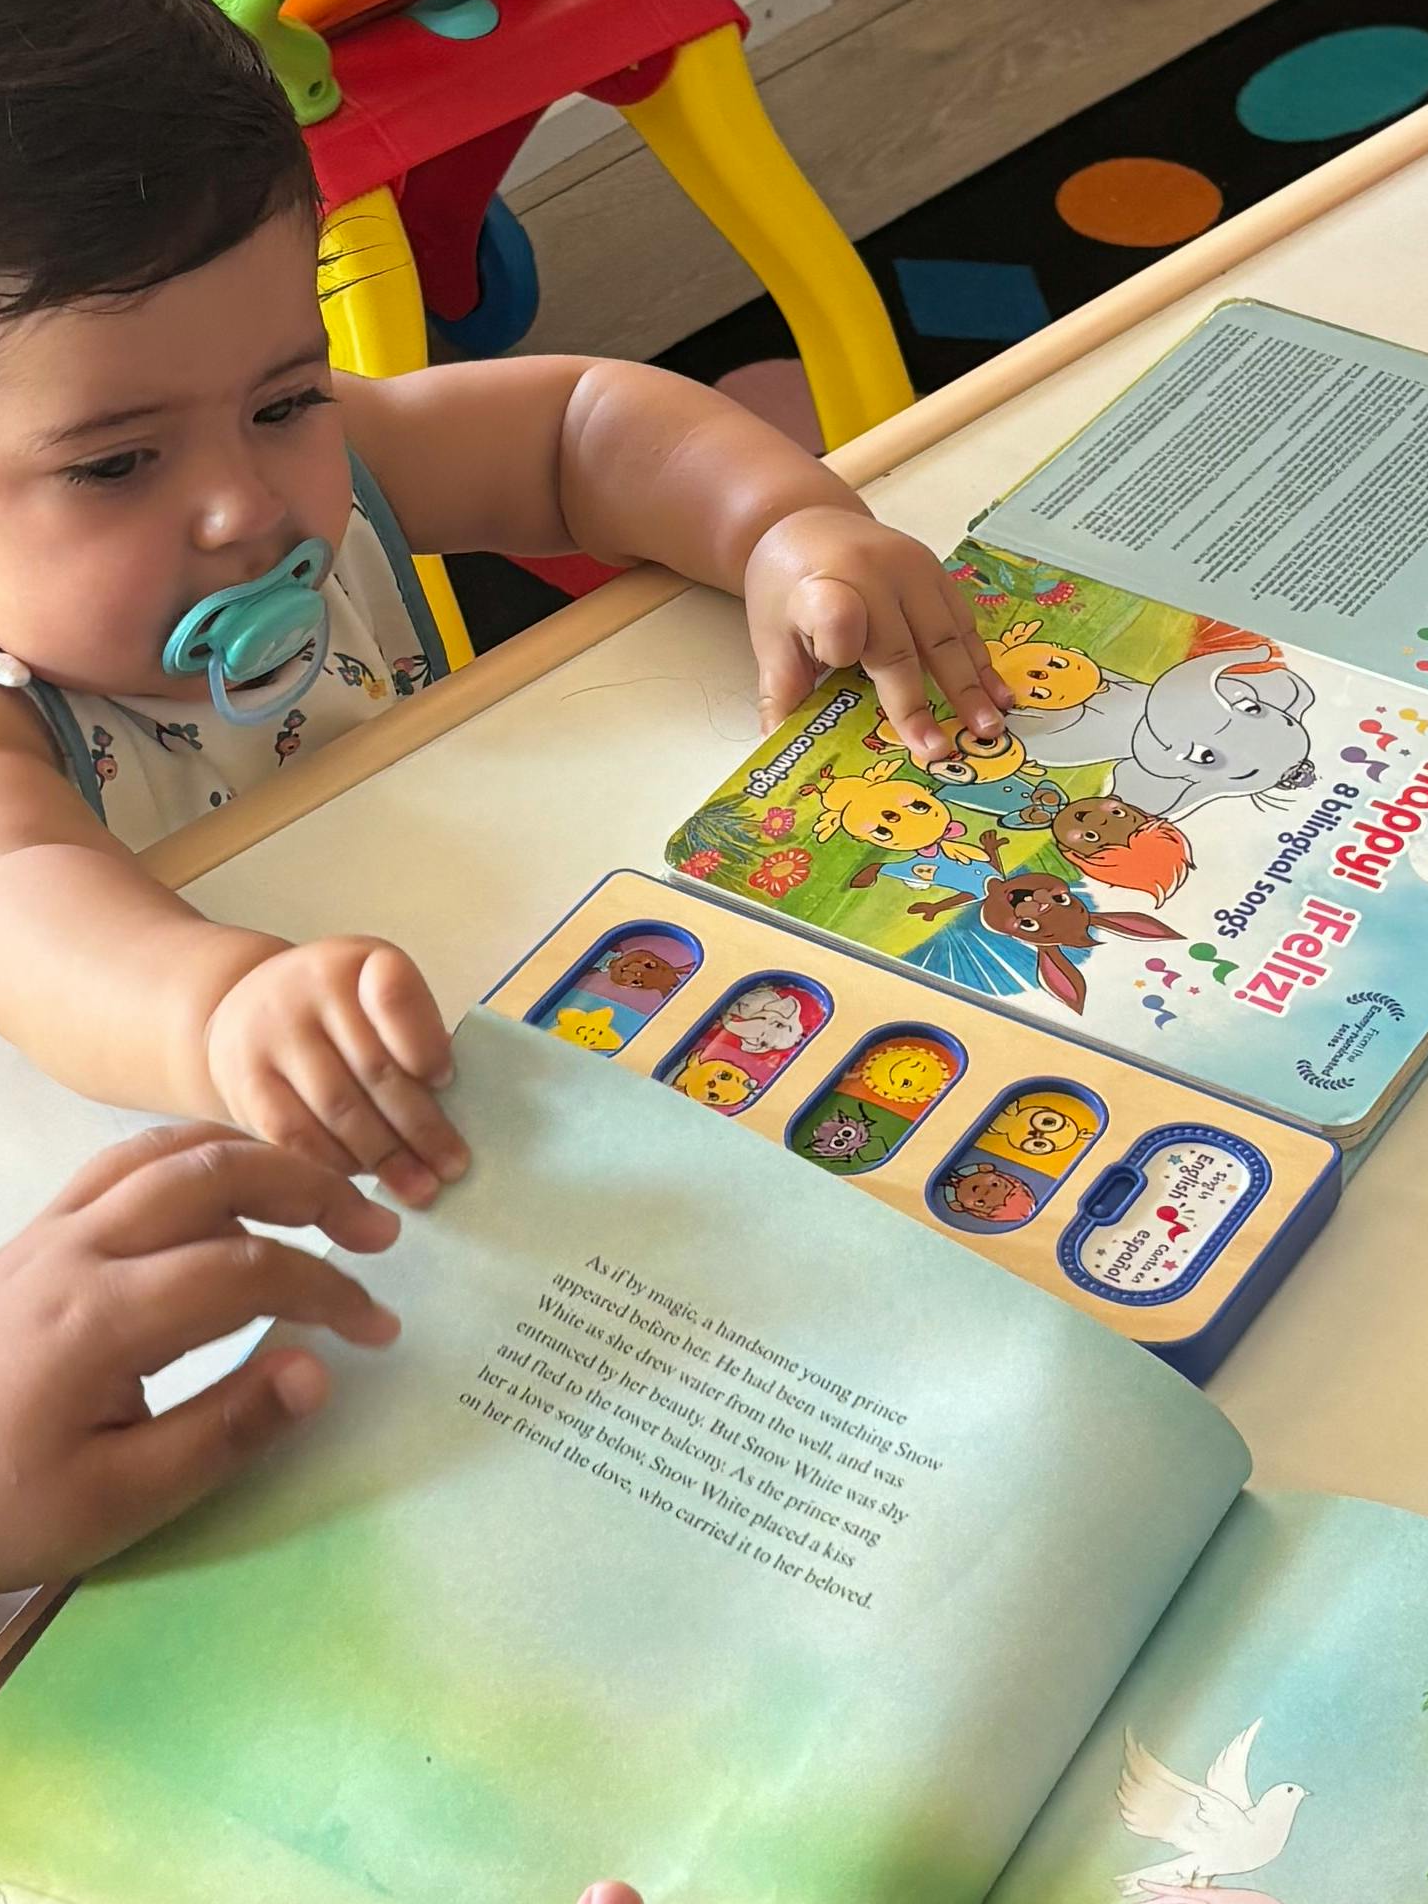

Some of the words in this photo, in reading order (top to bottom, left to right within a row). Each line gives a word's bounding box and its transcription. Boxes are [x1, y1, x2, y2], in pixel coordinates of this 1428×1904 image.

[746, 736, 813, 797] conmigo!
[1332, 782, 1360, 799] 8
[1213, 879, 1276, 940] songs
[1264, 798, 1353, 884] bilingual
[1234, 899, 1356, 1014] ¡Feliz!
[1168, 1153, 1215, 1200] English
[1103, 1228, 1151, 1284] español
[538, 1293, 585, 1329] White
[584, 1322, 605, 1340] as
[604, 1333, 634, 1355] she
[634, 1347, 678, 1377] drew
[678, 1370, 726, 1401] water
[723, 1392, 766, 1425] from
[766, 1415, 796, 1439] the
[798, 1431, 834, 1461] well,
[835, 1452, 873, 1474] and
[872, 1467, 905, 1488] was
[551, 1273, 631, 1319] appeared
[628, 1307, 681, 1346] before
[680, 1334, 712, 1363] her.
[714, 1353, 741, 1377] He
[740, 1366, 777, 1395] had
[774, 1383, 816, 1417] been
[819, 1409, 894, 1454] watching
[893, 1441, 943, 1471] Snow
[584, 1254, 610, 1276] As
[609, 1266, 631, 1284] if
[624, 1272, 648, 1297] by
[646, 1287, 699, 1325] magic,
[700, 1317, 714, 1331] a
[714, 1319, 800, 1374] handsome
[796, 1366, 853, 1404] young
[849, 1394, 908, 1425] prince
[476, 1363, 509, 1389] her
[506, 1383, 519, 1397] a
[518, 1384, 555, 1415] love
[554, 1409, 596, 1440] song
[594, 1425, 647, 1467] below,
[647, 1455, 698, 1489] Snow
[701, 1480, 751, 1519] White
[747, 1512, 811, 1547] placed
[807, 1539, 821, 1553] a
[821, 1540, 856, 1568] kiss
[496, 1343, 533, 1368] and
[529, 1358, 568, 1386] fled
[564, 1378, 583, 1396] to
[584, 1387, 613, 1411] the
[612, 1403, 661, 1437] tower
[660, 1425, 727, 1473] balcony.
[728, 1465, 756, 1487] As
[755, 1479, 785, 1502] the
[782, 1495, 841, 1527] prince
[840, 1520, 882, 1548] sang
[515, 1321, 599, 1369] entranced
[596, 1358, 619, 1383] by
[617, 1369, 649, 1395] her
[647, 1385, 706, 1428] beauty.
[708, 1417, 742, 1446] But
[740, 1435, 790, 1468] Snow
[793, 1458, 843, 1495] White
[845, 1487, 878, 1510] was
[877, 1501, 909, 1525] shy
[458, 1392, 482, 1411] on
[481, 1398, 513, 1426] her
[511, 1416, 565, 1454] friend
[562, 1445, 591, 1468] the
[590, 1460, 632, 1495] dove,
[638, 1486, 674, 1513] who
[674, 1507, 739, 1547] carried
[735, 1535, 753, 1555] it
[752, 1545, 772, 1564] to
[771, 1552, 804, 1578] her
[803, 1566, 873, 1610] beloved.
